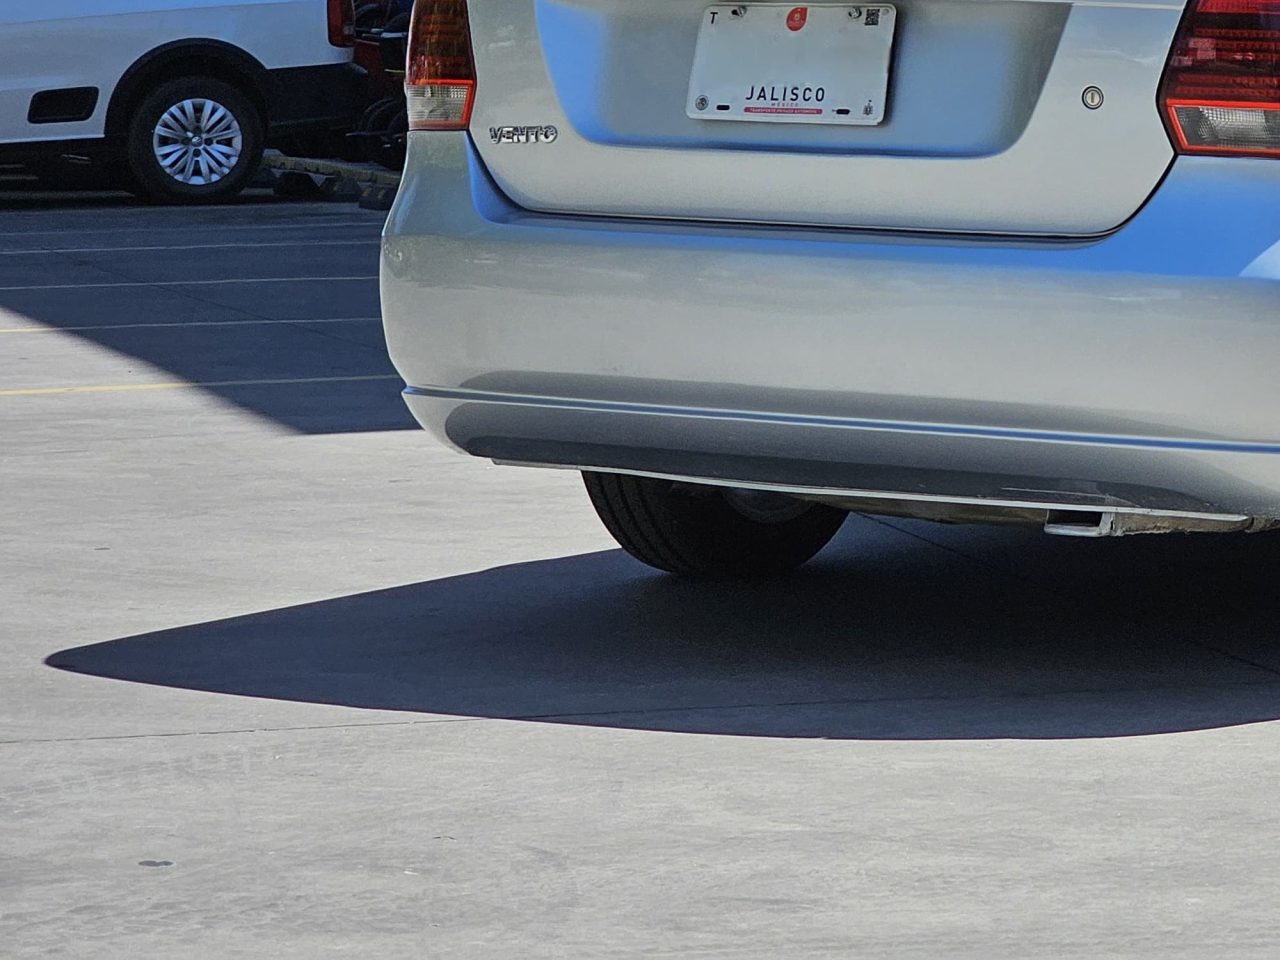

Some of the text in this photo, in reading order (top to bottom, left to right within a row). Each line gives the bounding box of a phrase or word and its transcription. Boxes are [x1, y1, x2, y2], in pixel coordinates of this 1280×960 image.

[710, 11, 719, 25] T
[745, 85, 826, 103] JALISCO
[489, 125, 558, 145] VENTO
